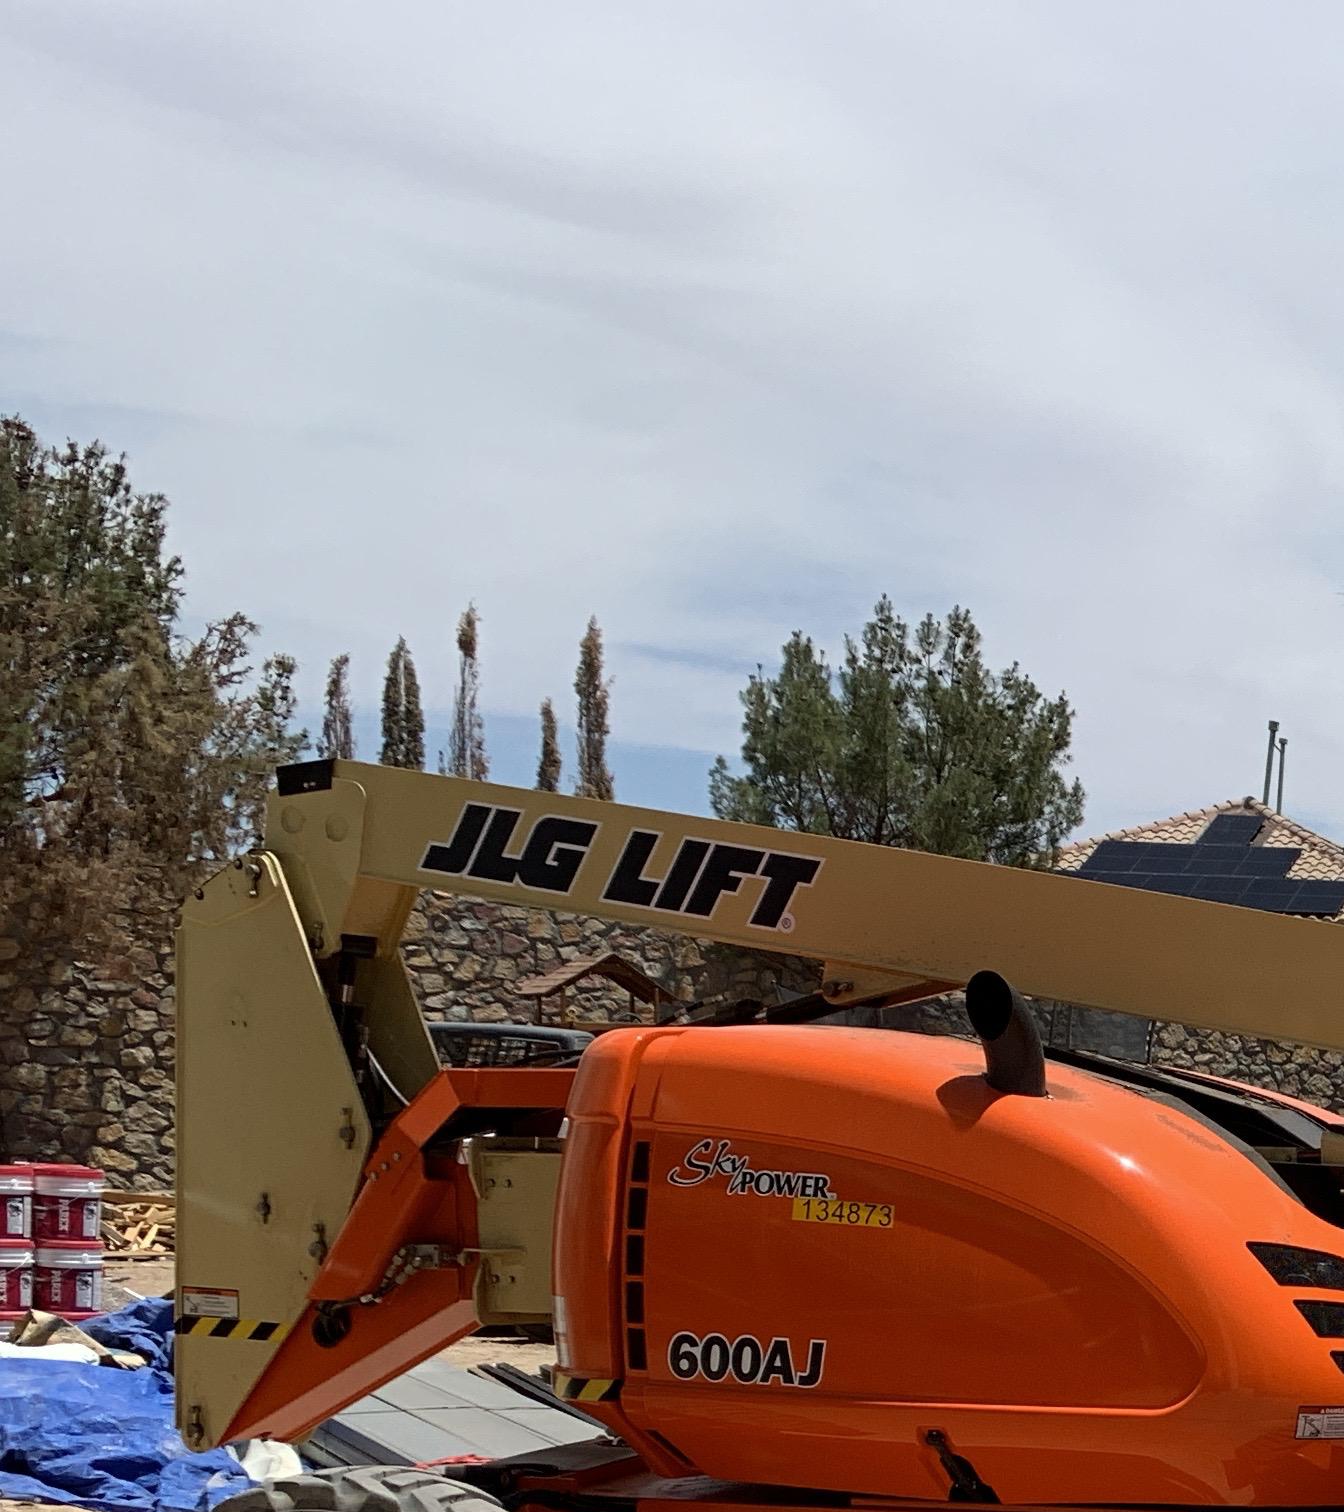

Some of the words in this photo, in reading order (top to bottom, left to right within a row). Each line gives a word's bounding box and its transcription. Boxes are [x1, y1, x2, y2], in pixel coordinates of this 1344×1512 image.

[418, 801, 602, 894] JLG
[600, 826, 826, 930] LIFT
[803, 1199, 894, 1227] 134873
[668, 1332, 827, 1389] 600AJ
